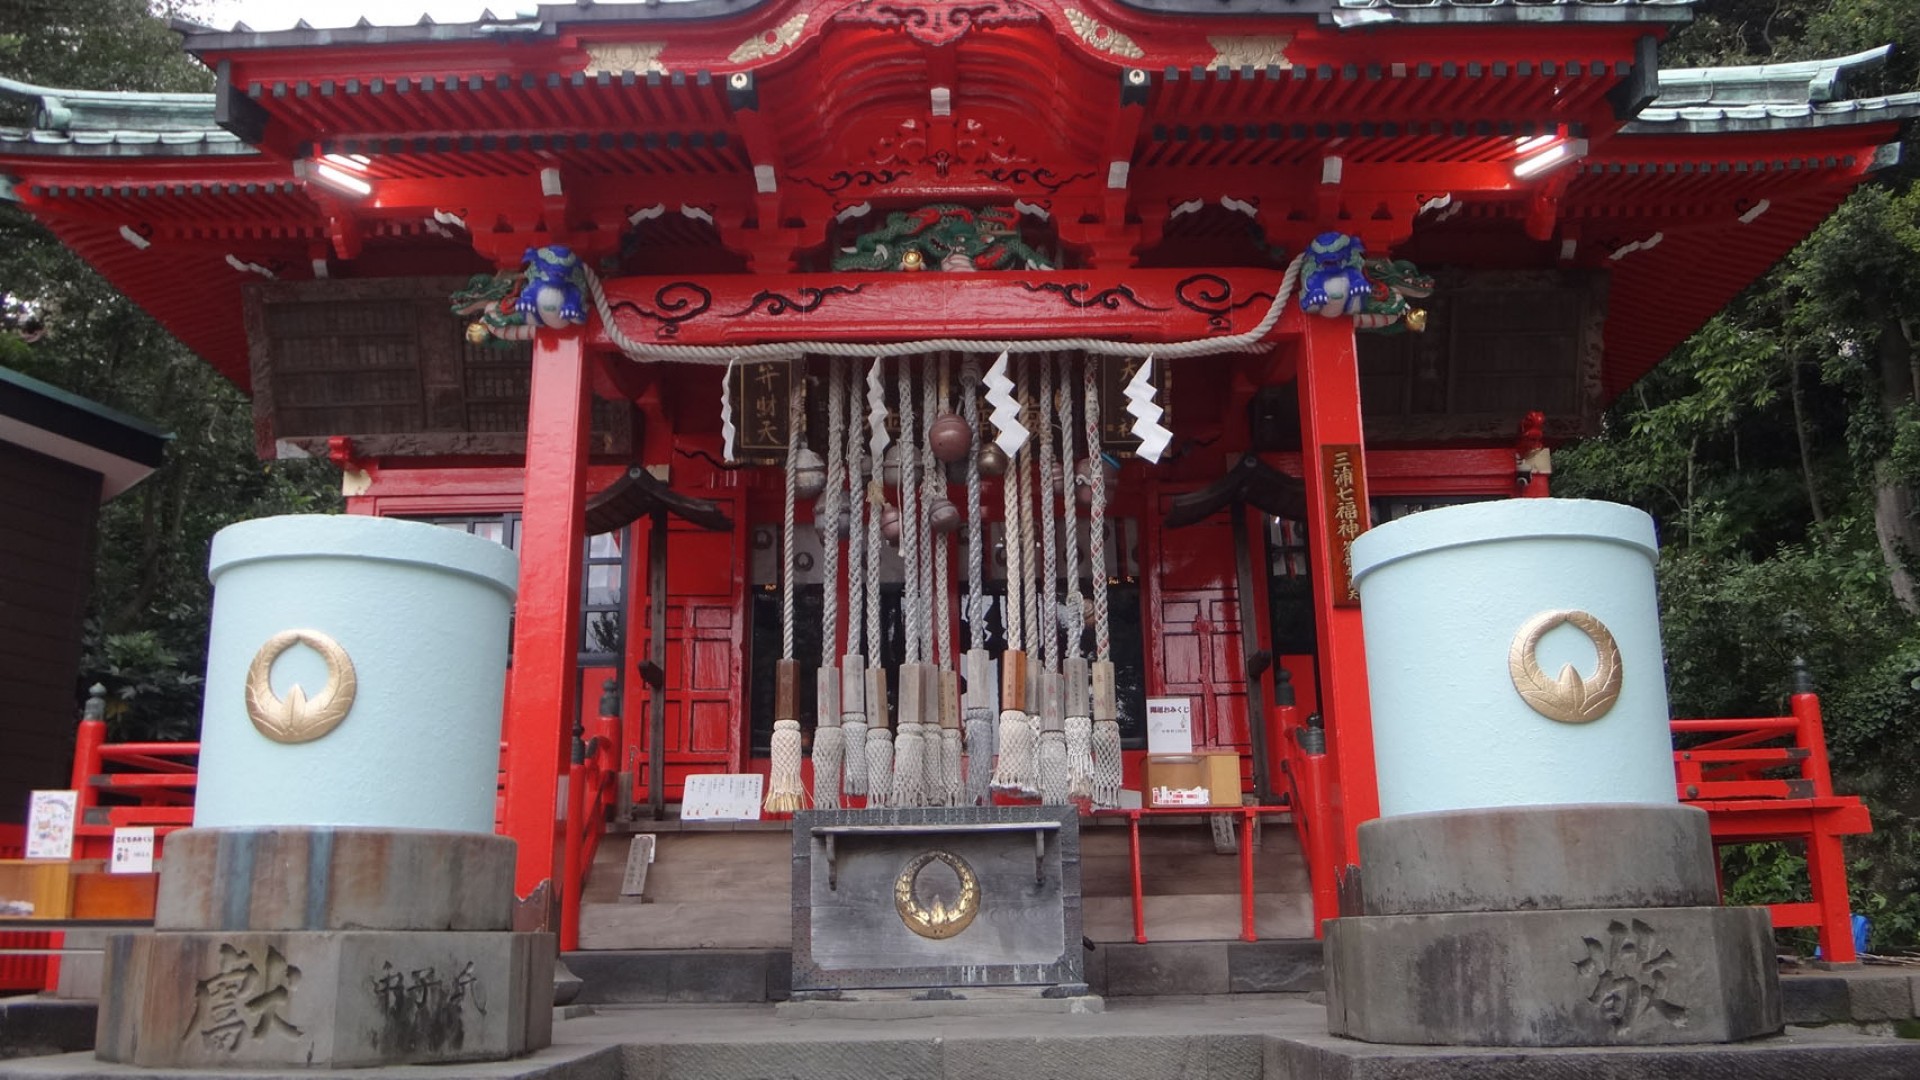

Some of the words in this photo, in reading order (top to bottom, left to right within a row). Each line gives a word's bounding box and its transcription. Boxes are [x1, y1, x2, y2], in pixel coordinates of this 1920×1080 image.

[1333, 451, 1360, 540] 三浦七福神
